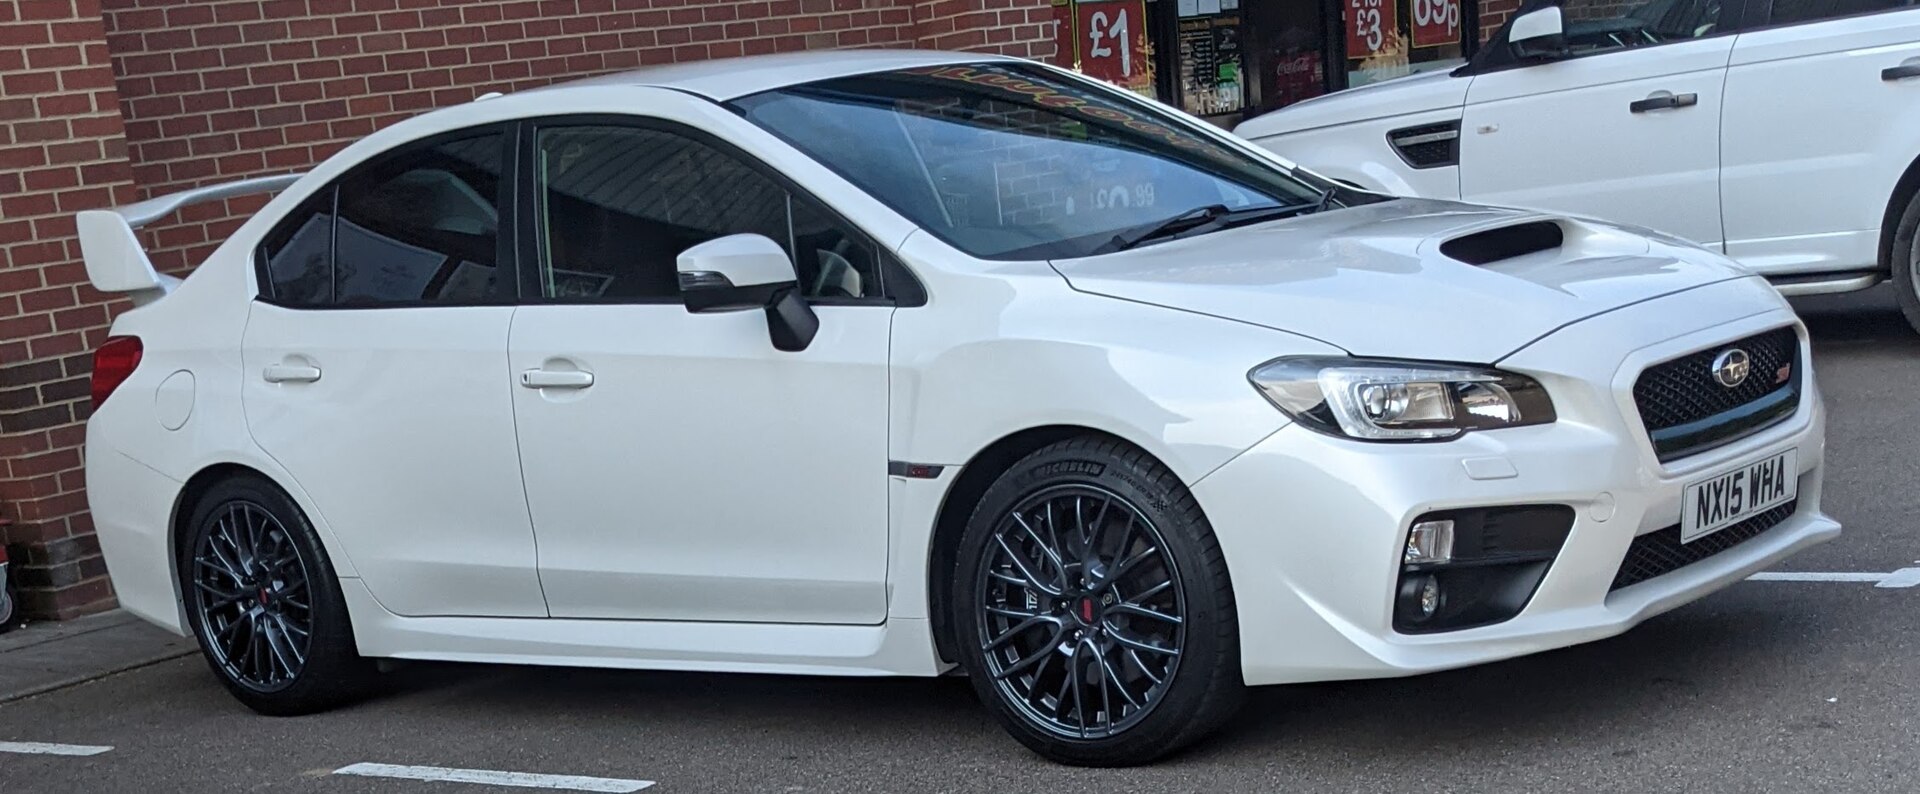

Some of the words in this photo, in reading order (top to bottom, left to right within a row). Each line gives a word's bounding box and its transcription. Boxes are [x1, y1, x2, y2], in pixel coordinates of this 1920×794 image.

[1089, 8, 1131, 77] £1
[1356, 8, 1383, 51] £3
[1033, 460, 1102, 476] MICHELIN
[1696, 470, 1744, 529] NX15
[1749, 455, 1784, 509] WHA
